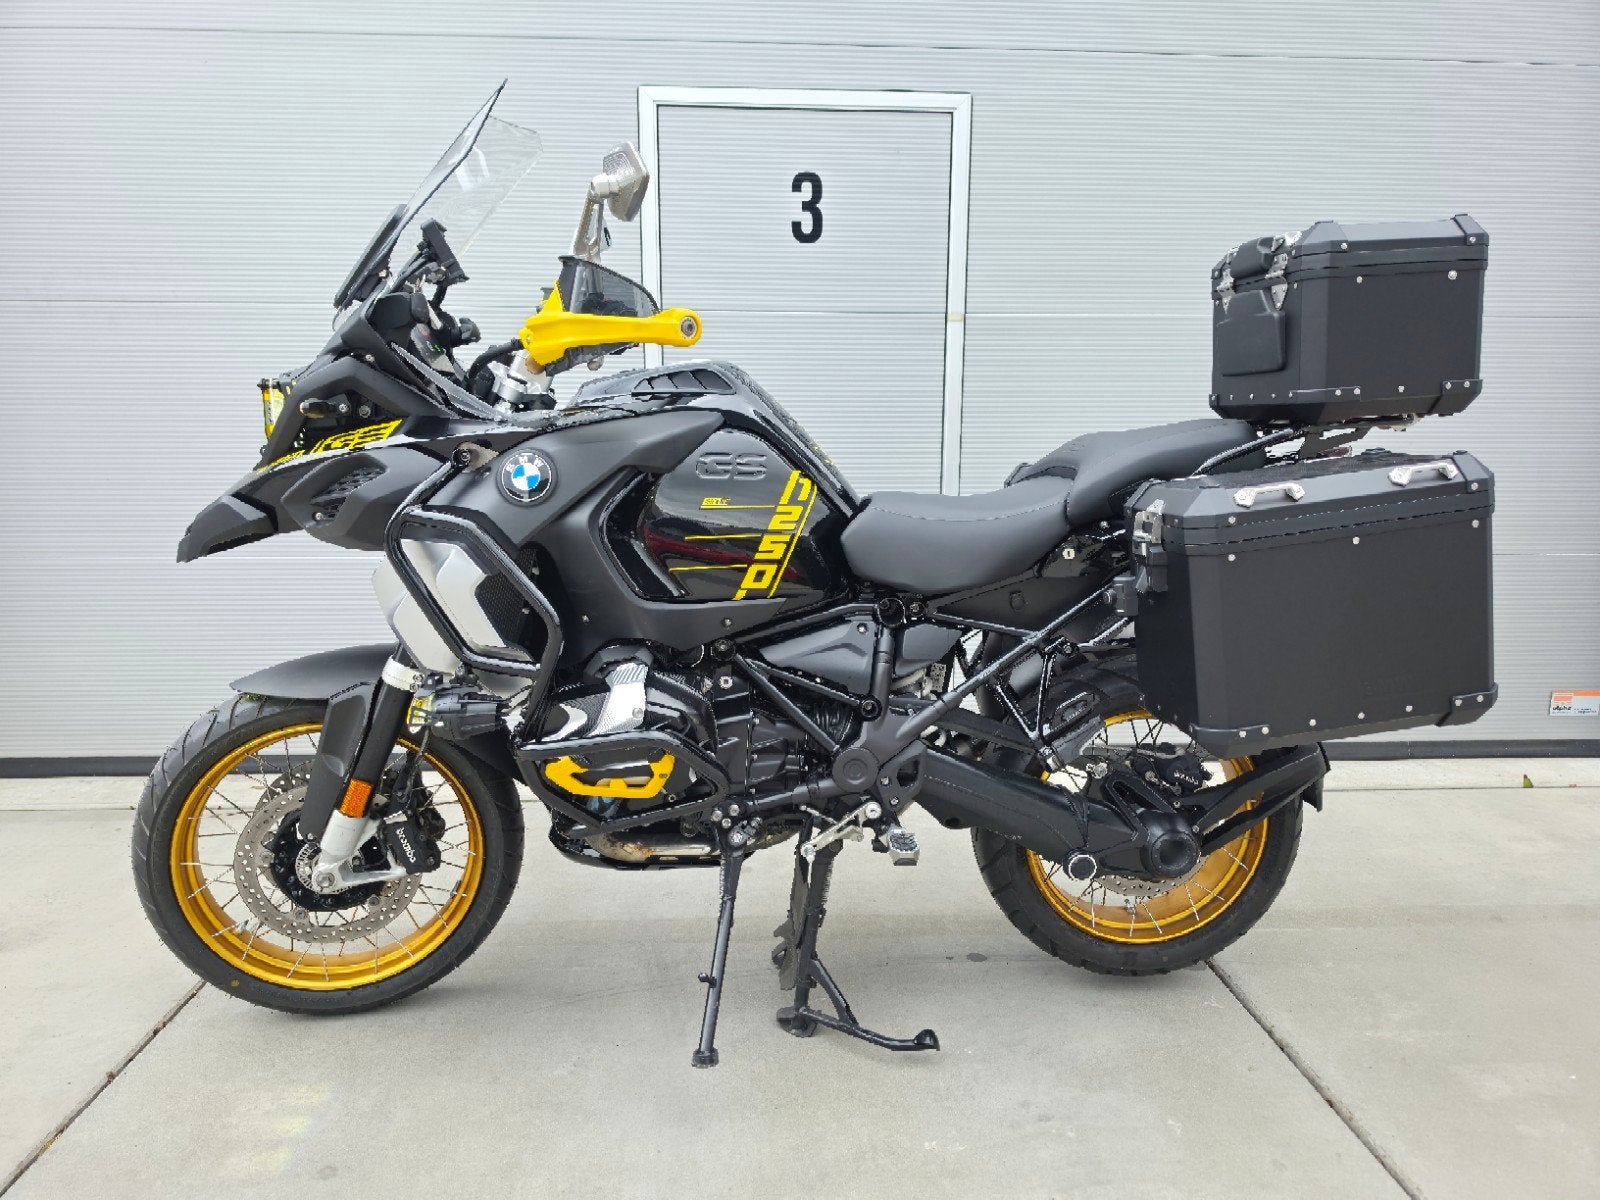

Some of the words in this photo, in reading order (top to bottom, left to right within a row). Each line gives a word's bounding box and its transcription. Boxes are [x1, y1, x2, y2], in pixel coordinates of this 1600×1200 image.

[791, 171, 823, 244] 3
[505, 455, 545, 473] BMW
[696, 452, 768, 480] GS
